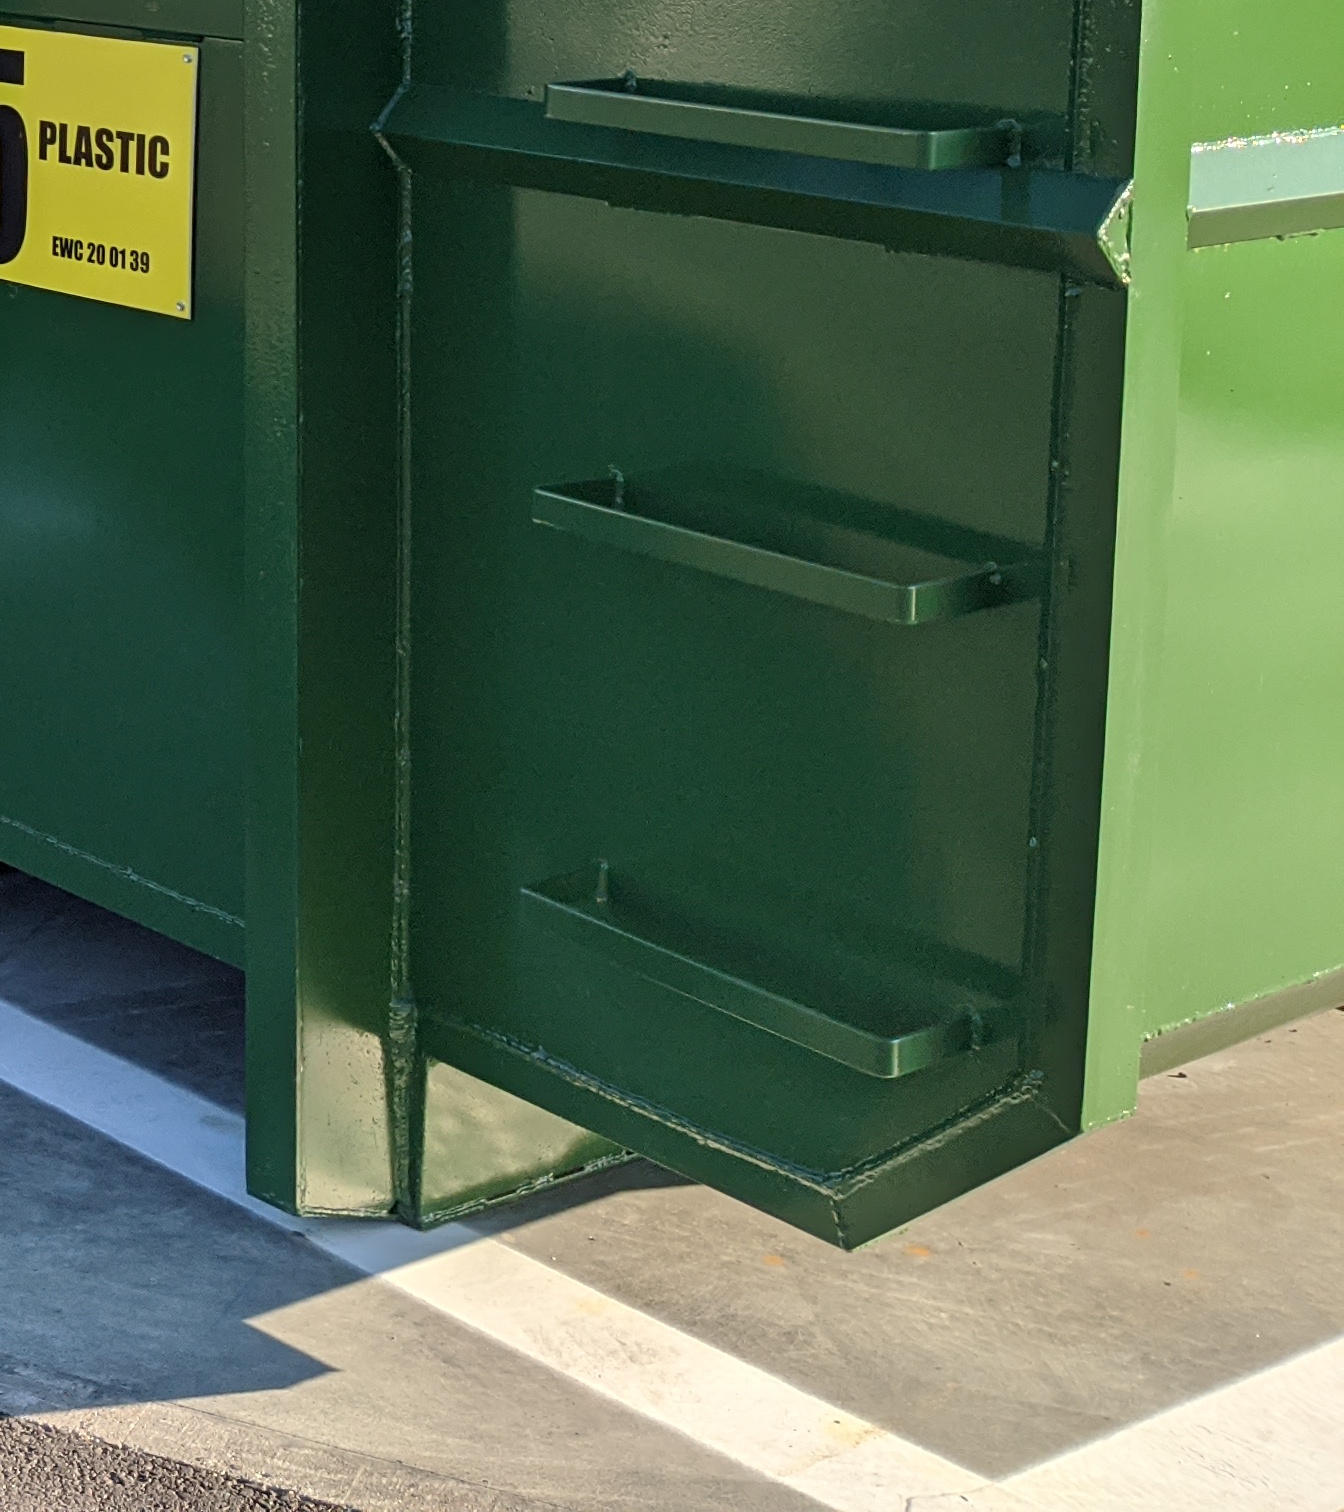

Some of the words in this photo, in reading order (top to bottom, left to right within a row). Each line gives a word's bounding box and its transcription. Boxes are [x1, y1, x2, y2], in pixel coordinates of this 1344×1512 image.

[38, 120, 170, 179] PLASTIC
[52, 235, 84, 262] EWC
[87, 242, 106, 266] 20
[109, 247, 127, 269] 01
[129, 250, 150, 274] 39
